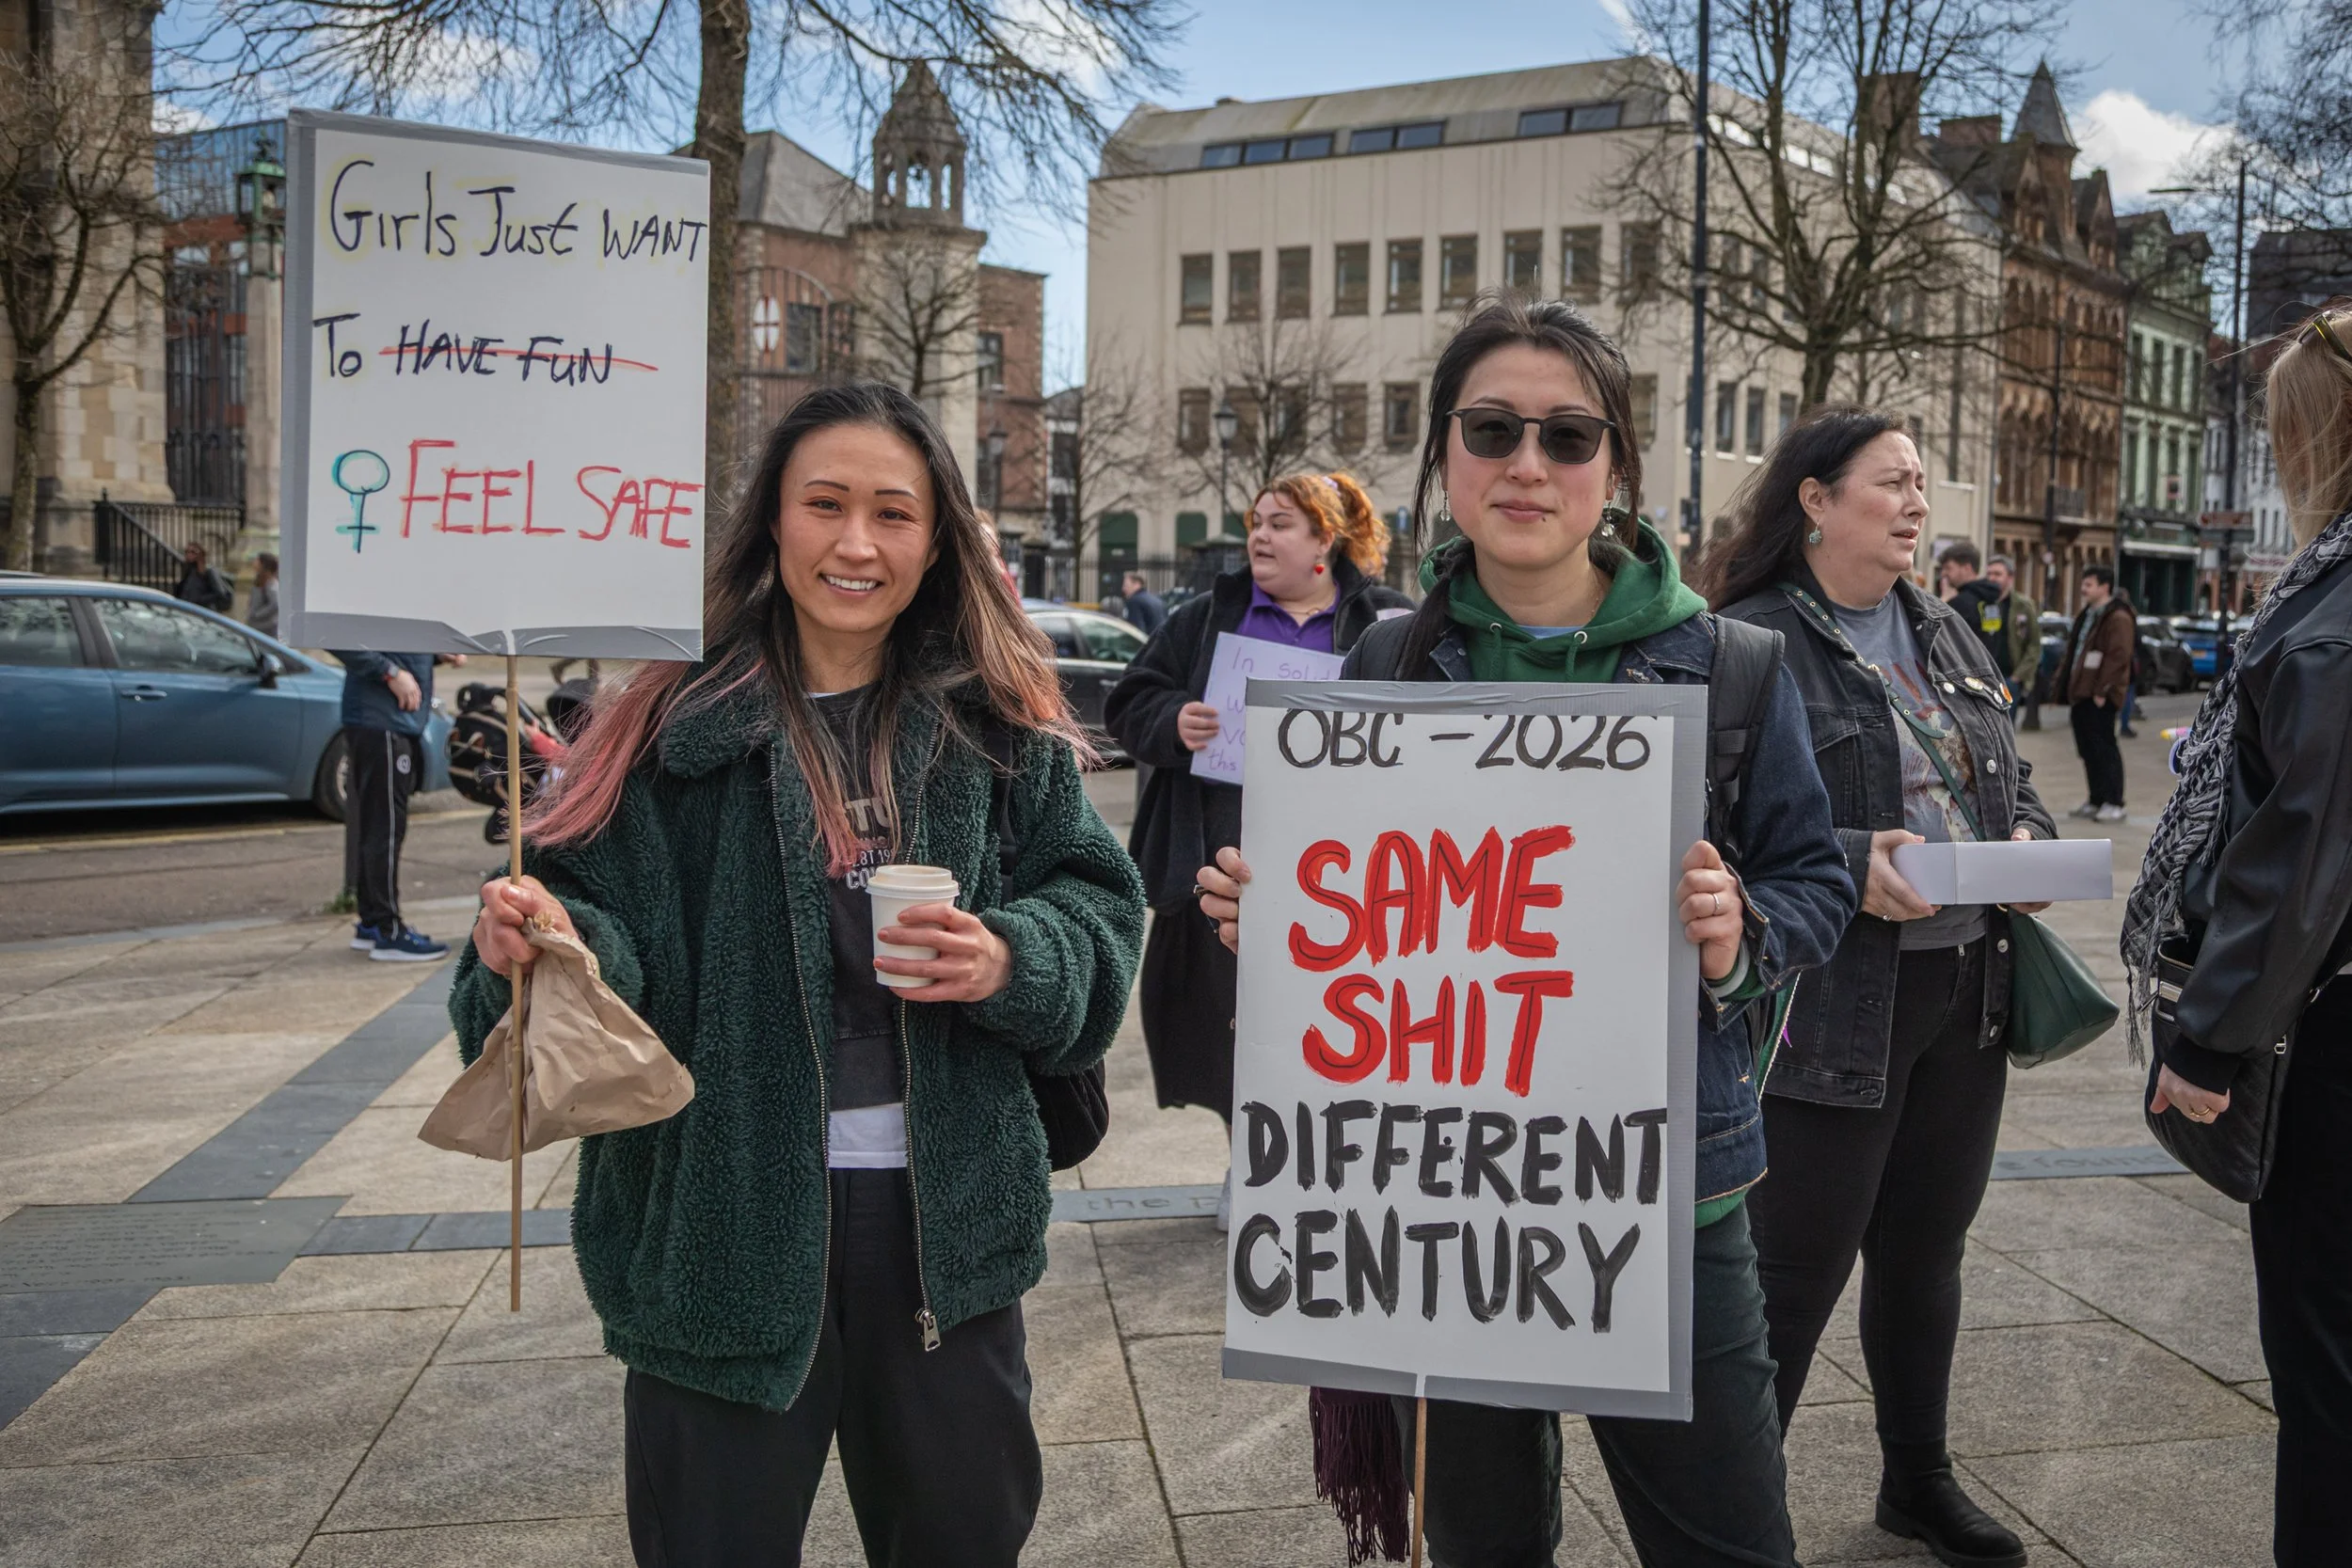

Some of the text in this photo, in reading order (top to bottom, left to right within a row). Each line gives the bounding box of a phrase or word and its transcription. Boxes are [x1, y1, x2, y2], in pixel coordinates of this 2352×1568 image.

[330, 160, 708, 261] Girls Just WANT
[312, 313, 613, 386] To HAVE FUN
[399, 438, 706, 549] FEEL SAFE
[1232, 646, 1254, 673] In
[1278, 707, 1404, 769] OBC
[1475, 715, 1658, 771] 2026
[1288, 825, 1576, 973] SAME
[1302, 970, 1575, 1098] SHIT
[1239, 1099, 1668, 1208] DIFFERENT
[1233, 1205, 1642, 1334] CENTURY
